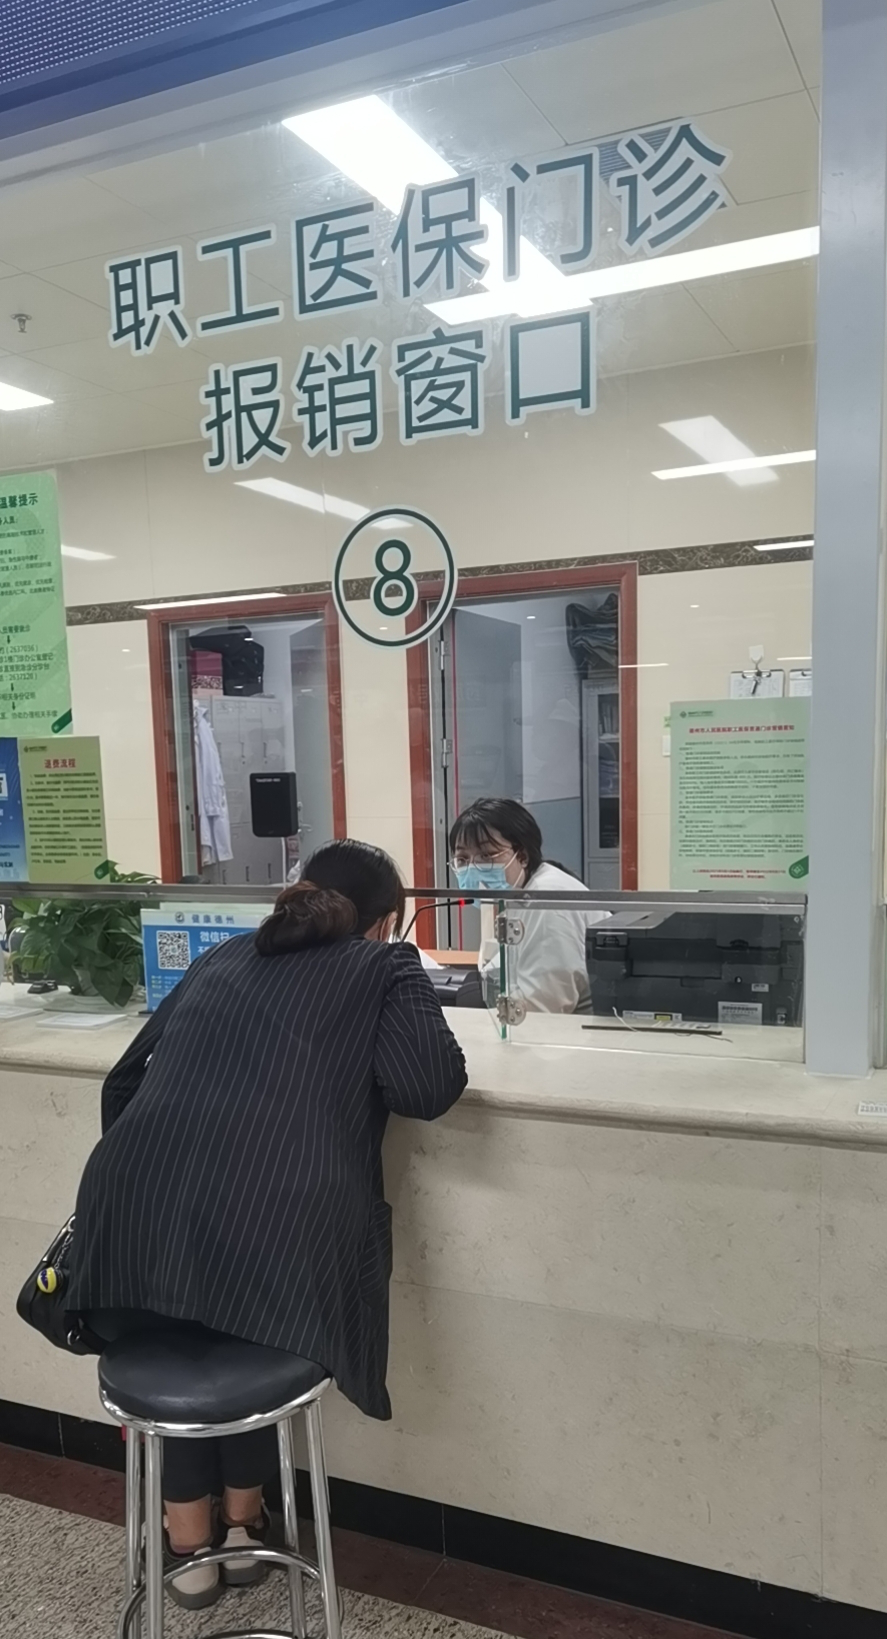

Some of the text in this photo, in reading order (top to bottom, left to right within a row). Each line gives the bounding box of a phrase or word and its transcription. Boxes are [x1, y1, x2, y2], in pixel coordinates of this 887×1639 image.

[108, 122, 728, 351] 职工医保门诊
[203, 311, 592, 468] 报销窗口
[44, 758, 76, 769] 退费流程
[191, 914, 235, 925] 健康德州
